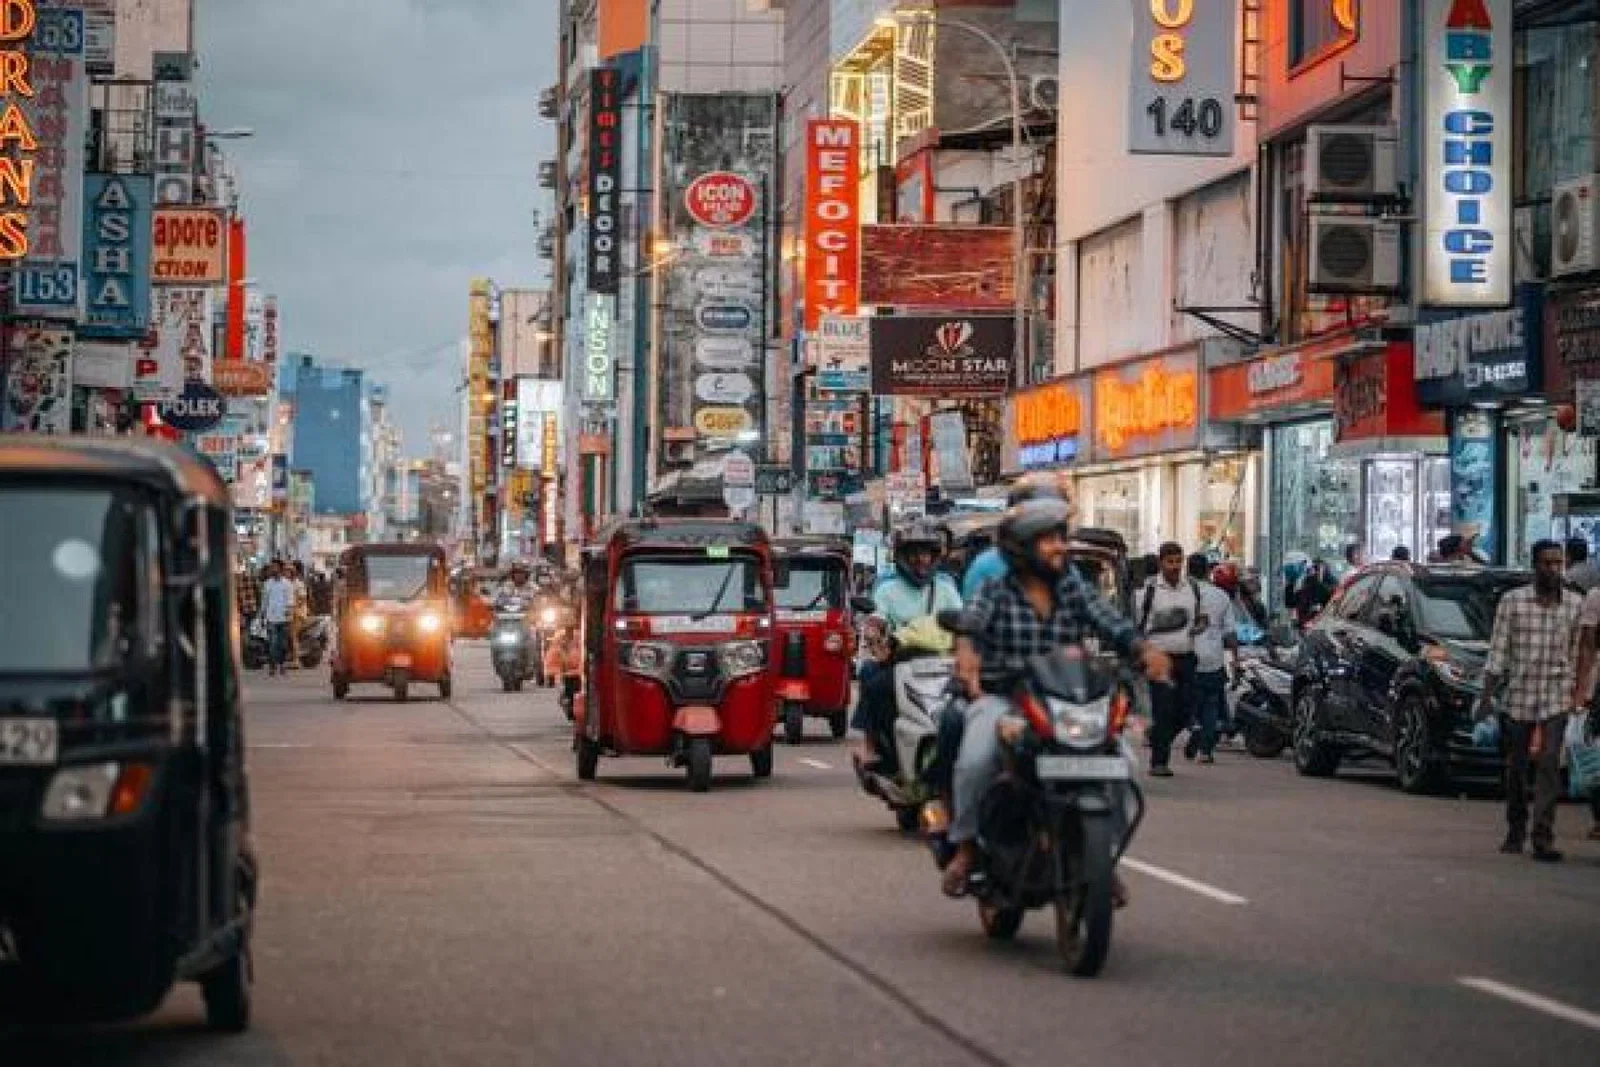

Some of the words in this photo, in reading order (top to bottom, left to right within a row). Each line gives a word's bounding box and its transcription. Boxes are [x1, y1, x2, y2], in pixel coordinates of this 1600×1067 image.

[1147, 95, 1222, 138] 140
[1444, 111, 1494, 284] CHOICE
[96, 177, 131, 306] ASHA
[22, 267, 74, 300] 153
[892, 358, 955, 372] MOON
[962, 357, 1008, 372] STAR
